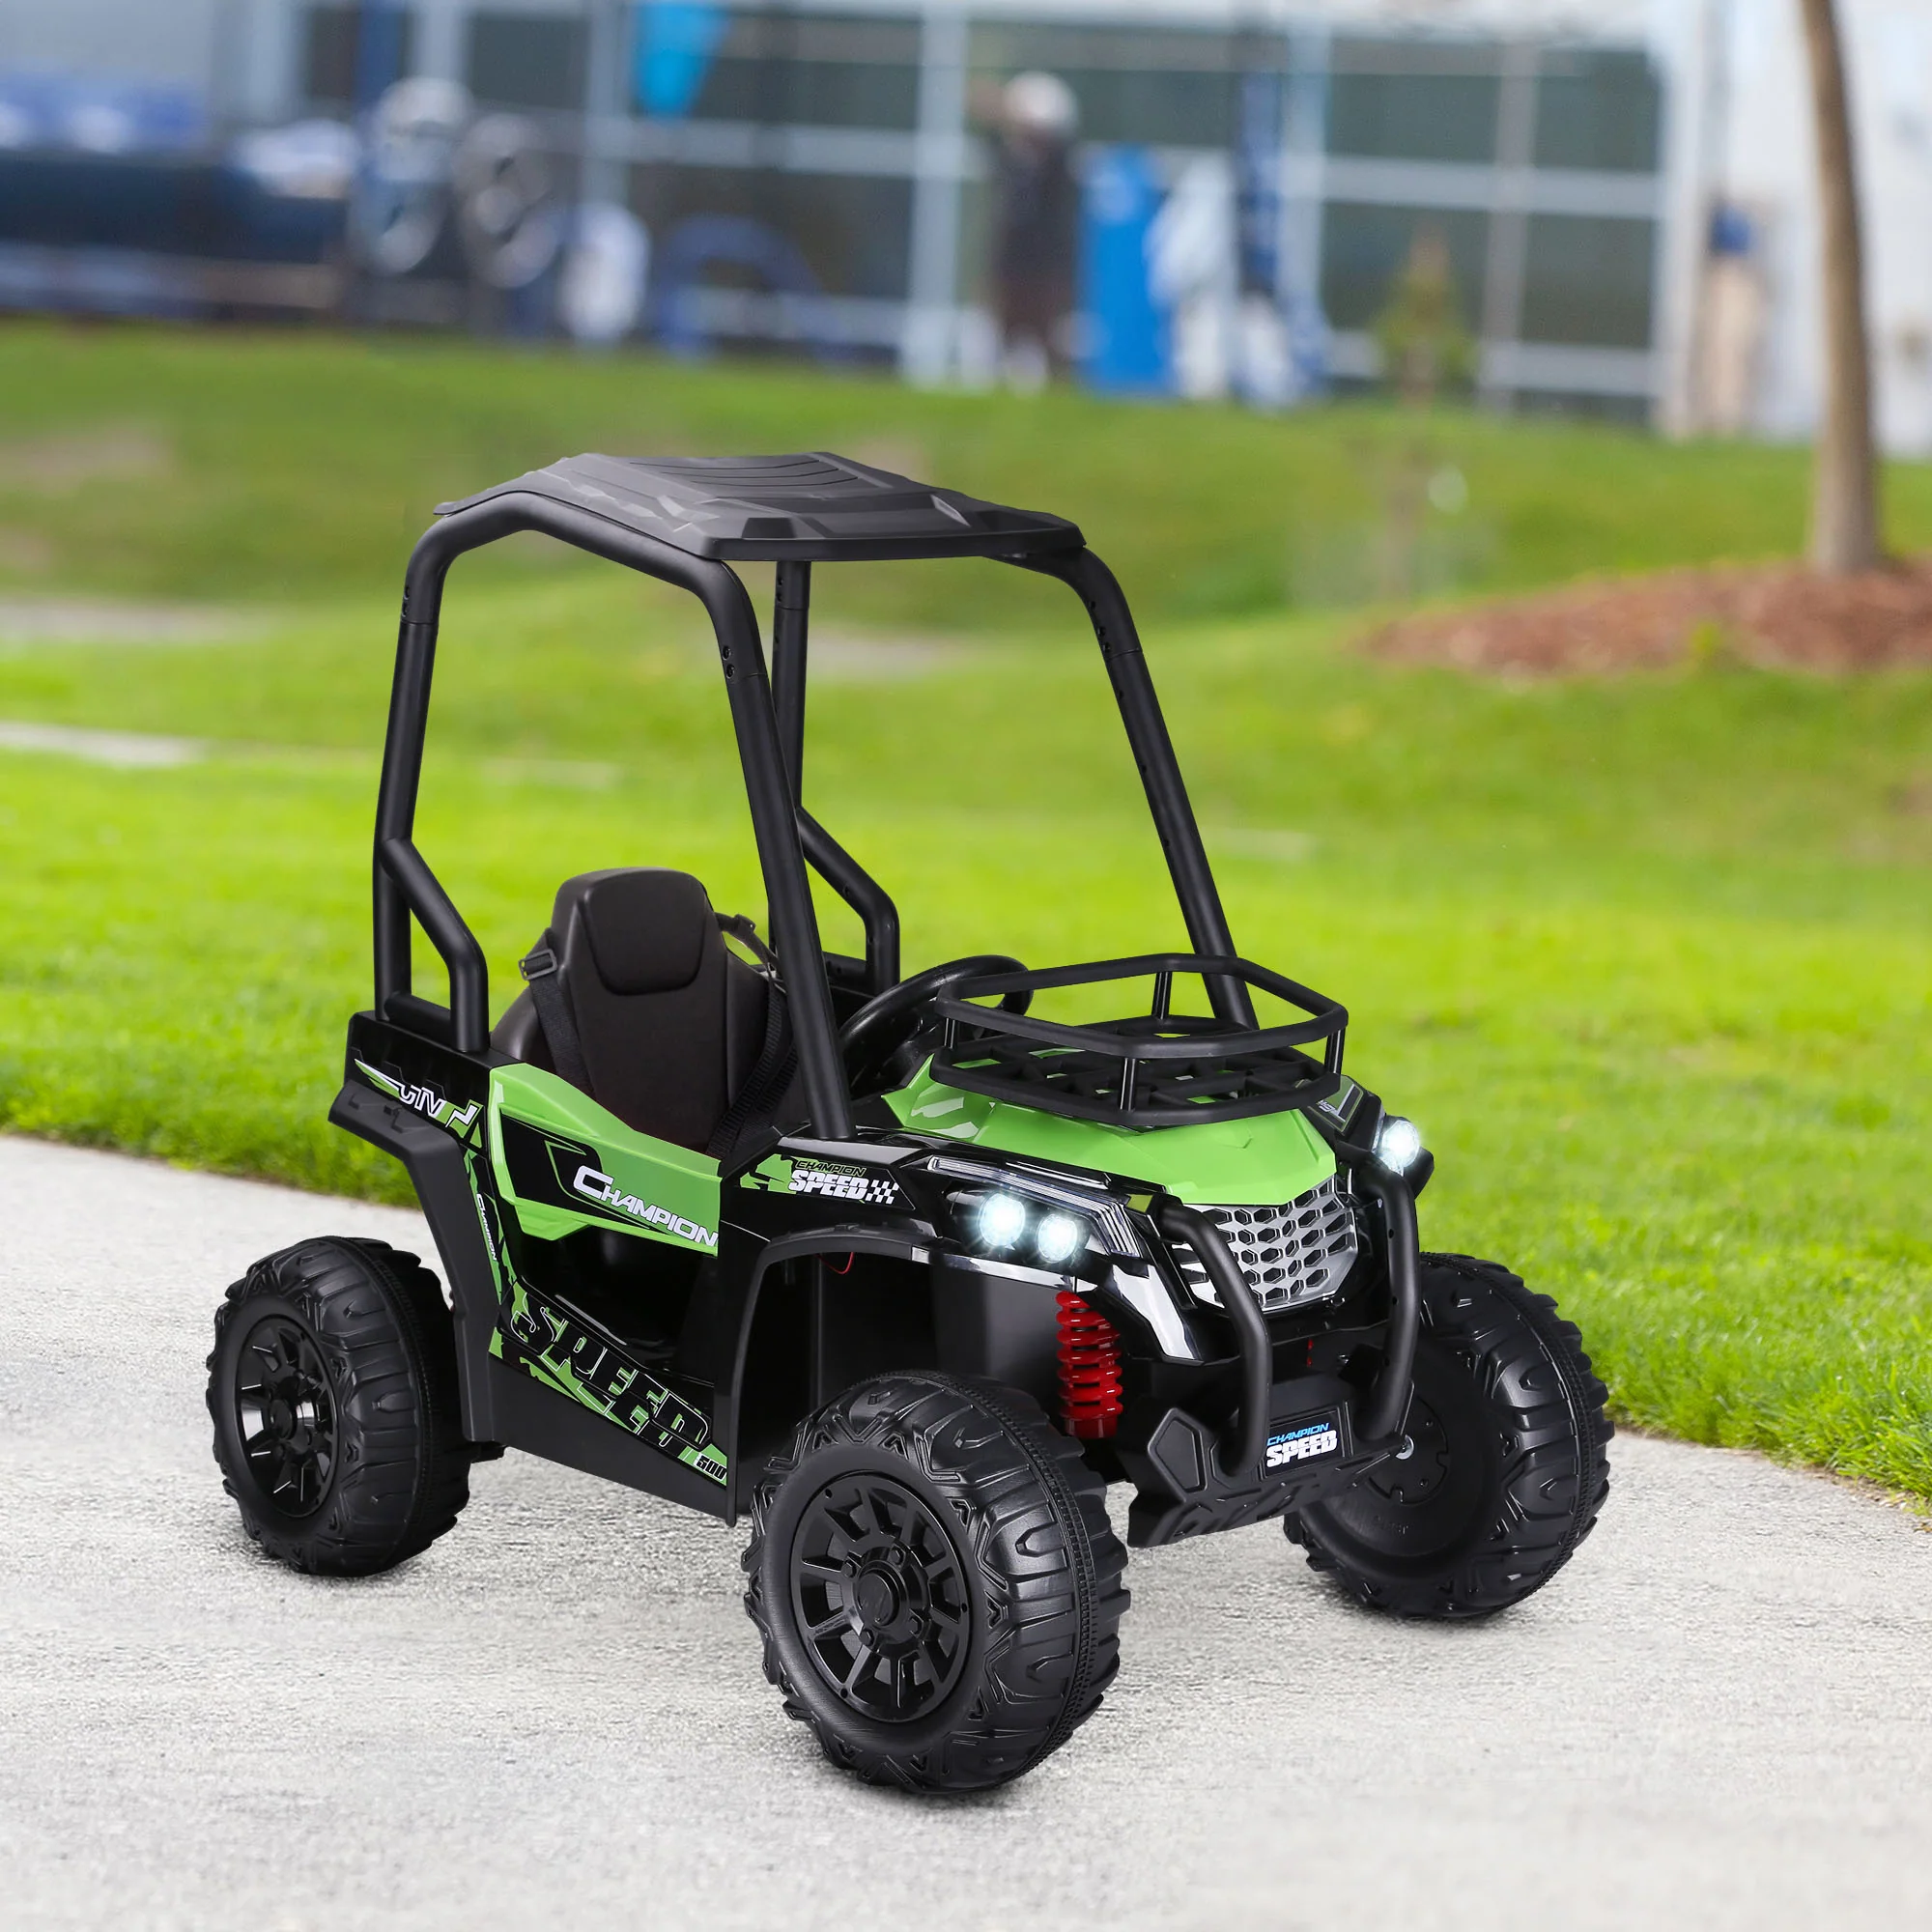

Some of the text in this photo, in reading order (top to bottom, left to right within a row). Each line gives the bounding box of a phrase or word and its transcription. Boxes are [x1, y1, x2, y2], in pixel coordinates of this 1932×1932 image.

[788, 1170, 869, 1200] SPEED
[795, 1160, 867, 1177] CHAMPION
[573, 1165, 718, 1246] CHAMPION
[476, 1193, 497, 1261] CHAMPION
[510, 1294, 710, 1451] SPEED
[1266, 1422, 1329, 1446] CHAMPION
[1266, 1430, 1337, 1467] SPEED
